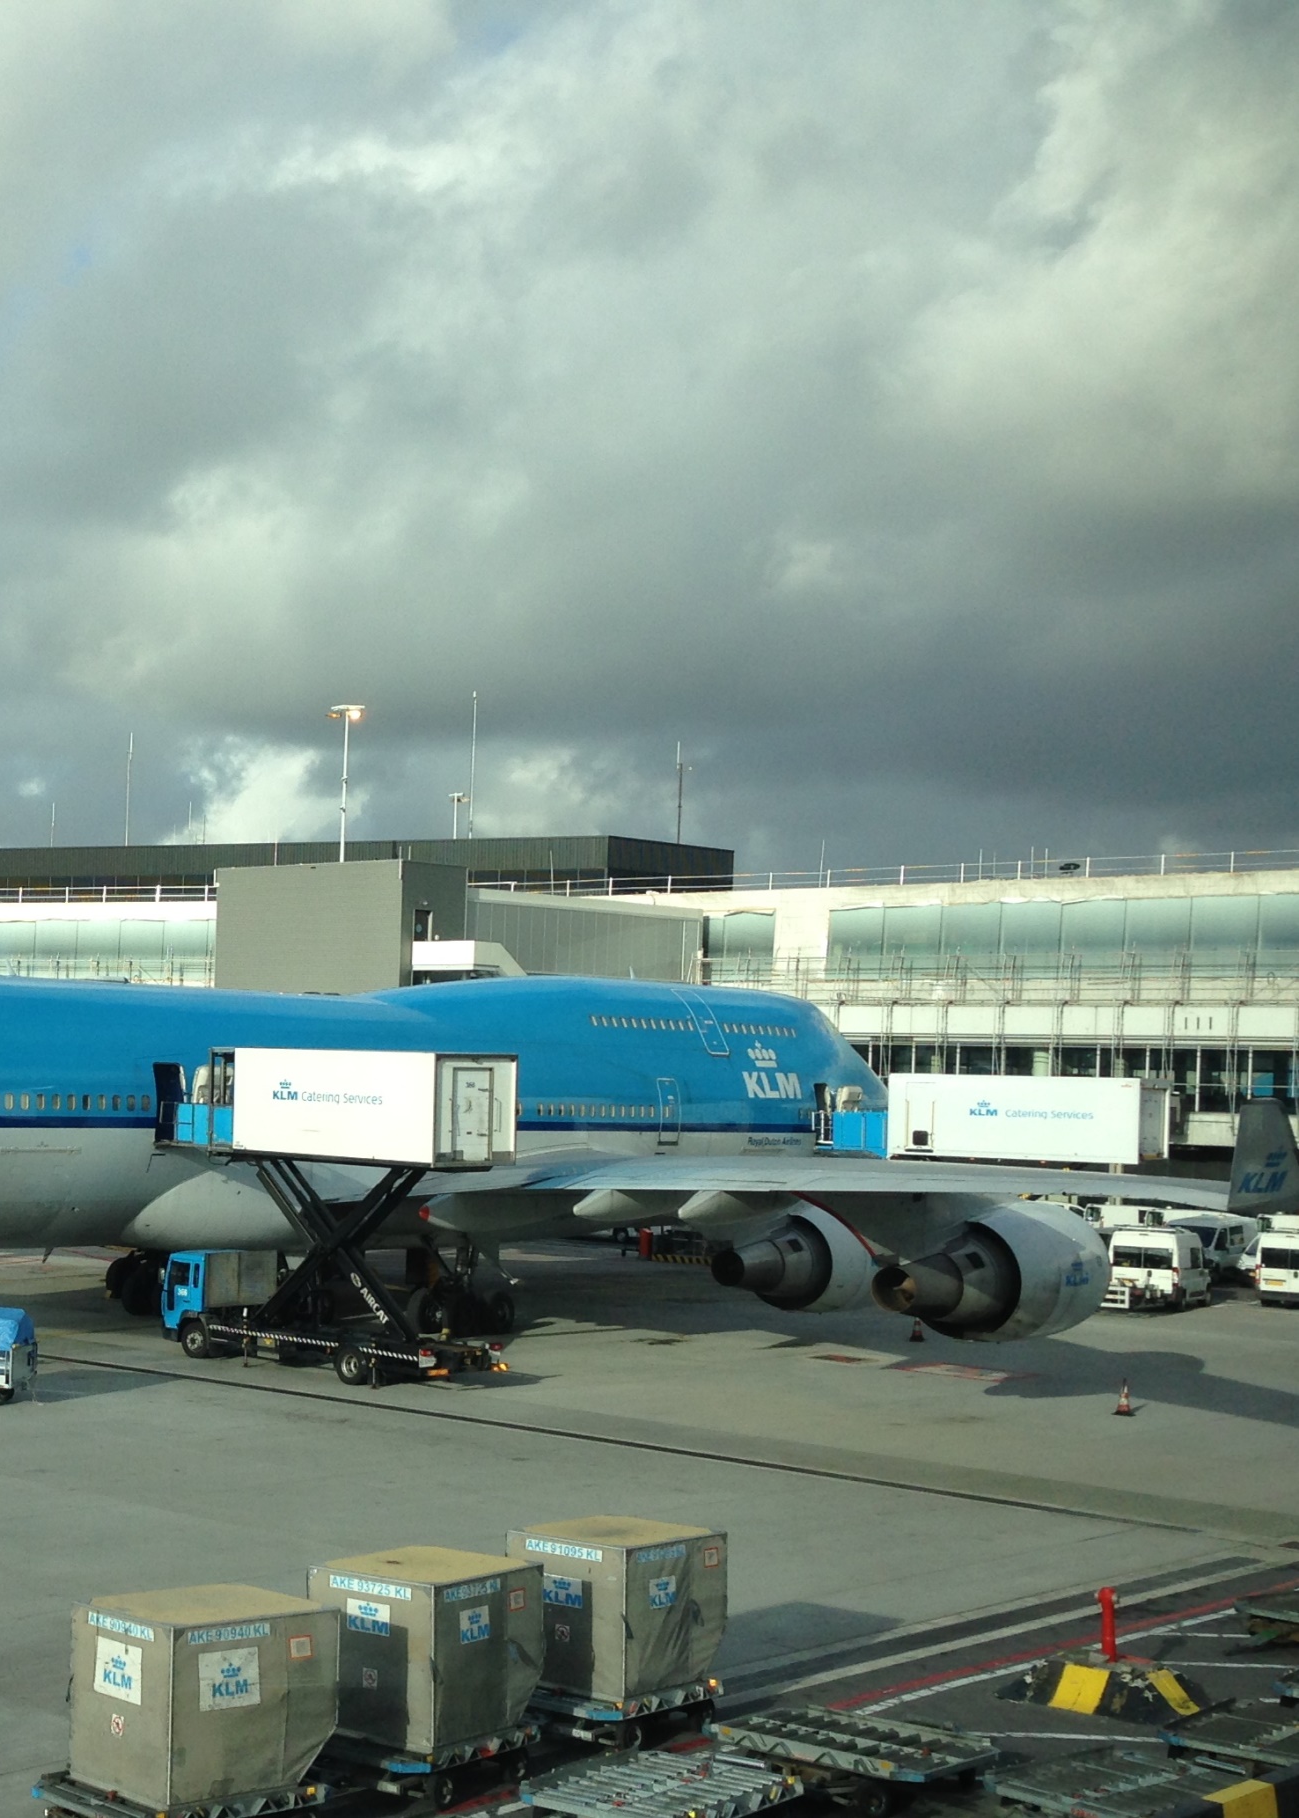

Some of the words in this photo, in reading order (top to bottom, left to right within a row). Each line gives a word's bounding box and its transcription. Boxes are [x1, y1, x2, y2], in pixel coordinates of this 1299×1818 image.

[742, 1071, 802, 1099] KLM
[272, 1090, 298, 1100] KLM
[301, 1091, 340, 1104] Catering
[343, 1093, 383, 1105] Services
[969, 1108, 998, 1116] KLM
[1005, 1108, 1048, 1119] Catering
[1051, 1110, 1094, 1120] Services
[1238, 1170, 1287, 1194] KLM
[360, 1287, 389, 1324] AIRCAT
[526, 1540, 549, 1552] AKE
[550, 1543, 583, 1557] 91095
[585, 1550, 601, 1561] KL
[331, 1577, 354, 1589] AKE
[357, 1580, 391, 1596] 93725
[394, 1587, 410, 1600] KL
[543, 1588, 583, 1607] KLM
[89, 1613, 108, 1628] AKE
[140, 1627, 152, 1641] KL
[189, 1629, 213, 1644] AKE
[215, 1626, 251, 1640] 90940
[253, 1622, 269, 1637] KL
[348, 1615, 389, 1635] KLM
[461, 1624, 490, 1642] KLM
[103, 1668, 132, 1690] KLM
[212, 1679, 249, 1698] KLM
